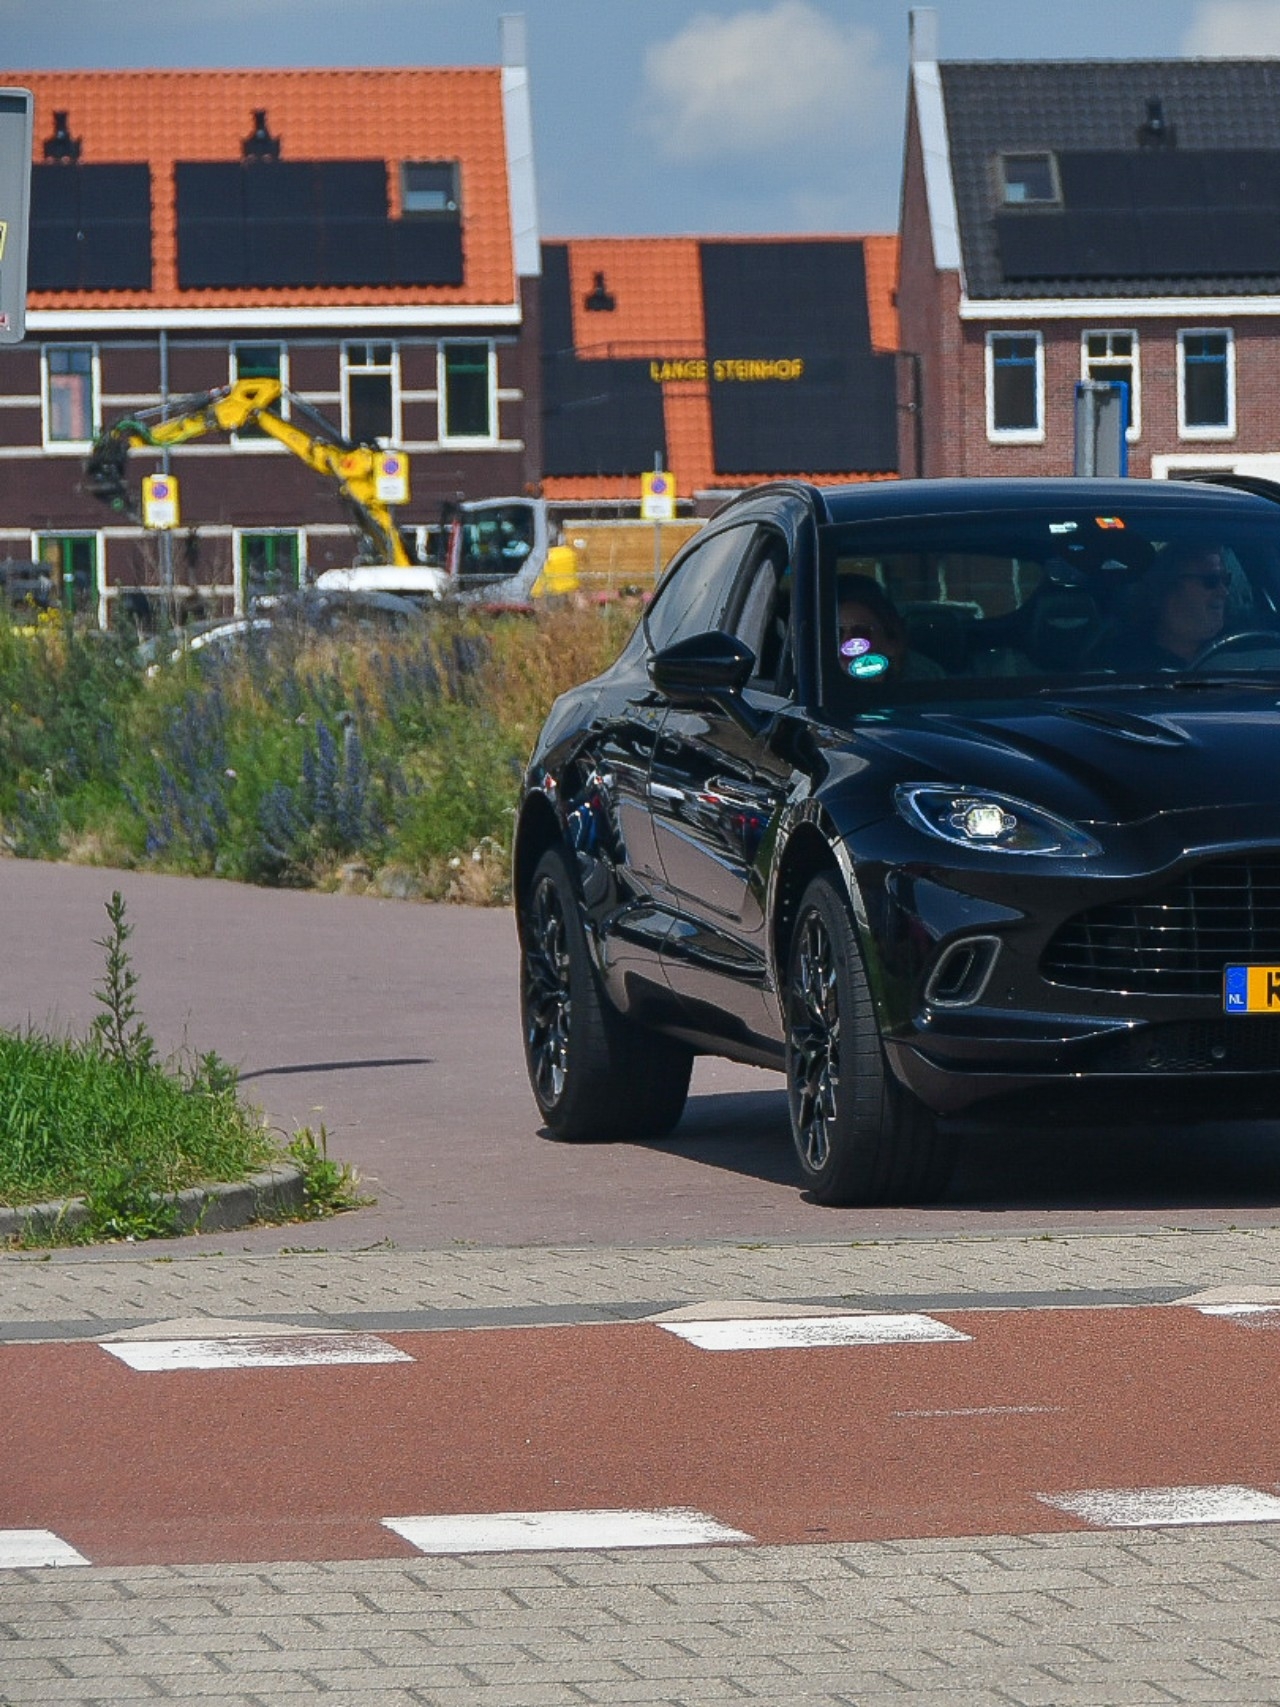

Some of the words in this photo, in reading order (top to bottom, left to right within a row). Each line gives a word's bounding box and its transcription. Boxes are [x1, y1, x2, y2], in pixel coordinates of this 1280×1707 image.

[650, 360, 708, 382] LANGE
[713, 359, 803, 381] STEINHOF
[1229, 994, 1244, 1005] NL
